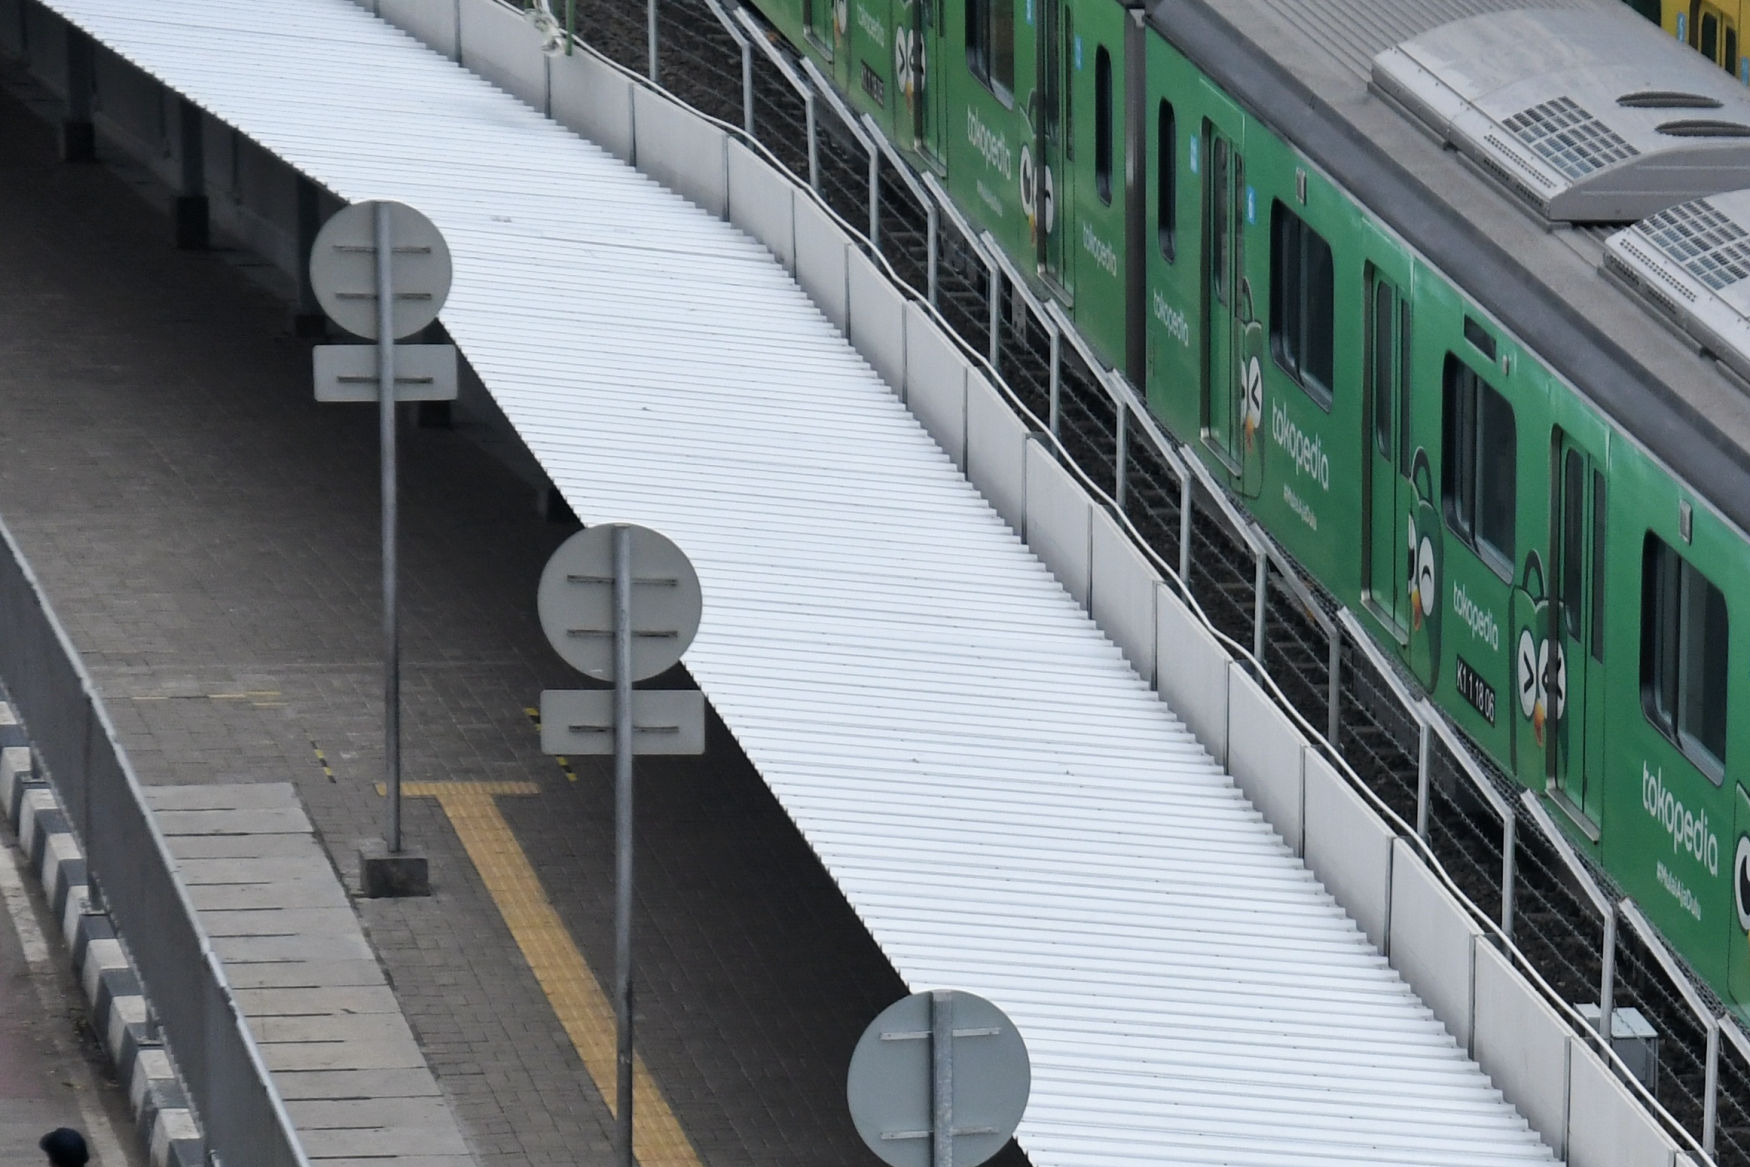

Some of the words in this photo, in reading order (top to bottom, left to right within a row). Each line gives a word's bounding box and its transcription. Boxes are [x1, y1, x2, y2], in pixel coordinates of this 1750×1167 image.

[967, 104, 1012, 181] tokopedia
[1272, 397, 1329, 492] tokopedia
[1453, 580, 1499, 651] tokopedia
[1642, 760, 1719, 878] tokopedia
